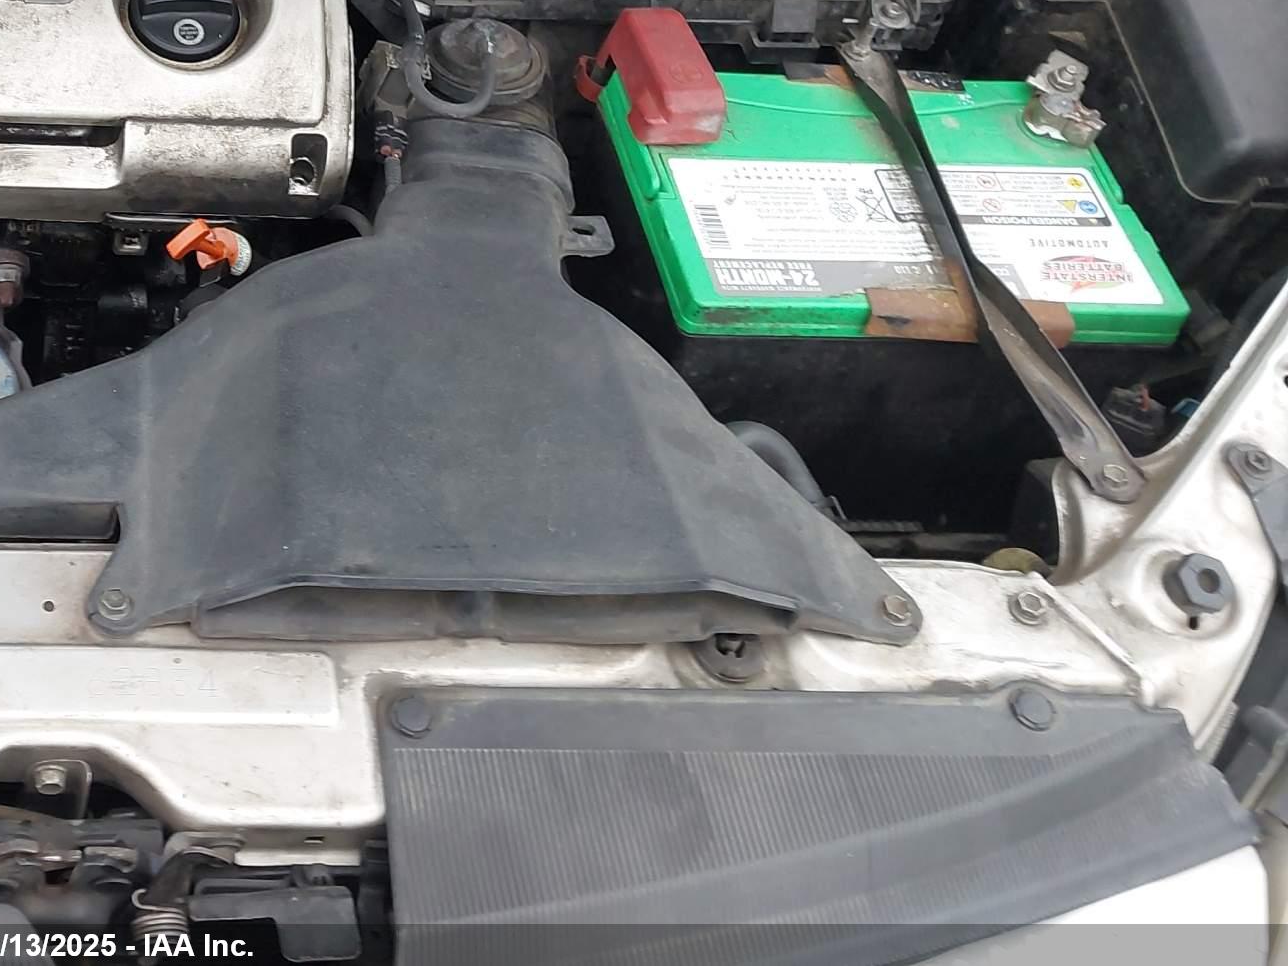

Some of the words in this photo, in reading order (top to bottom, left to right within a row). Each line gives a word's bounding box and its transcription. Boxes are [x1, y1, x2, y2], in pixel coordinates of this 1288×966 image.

[981, 216, 1080, 226] DANGER/POISON
[1028, 239, 1109, 249] AUTOMOTIVE
[712, 260, 785, 270] REPLACEMENT
[1042, 262, 1123, 272] BATTERIES
[715, 268, 820, 286] 24-MONTH
[1040, 272, 1134, 283] INTERSTATE
